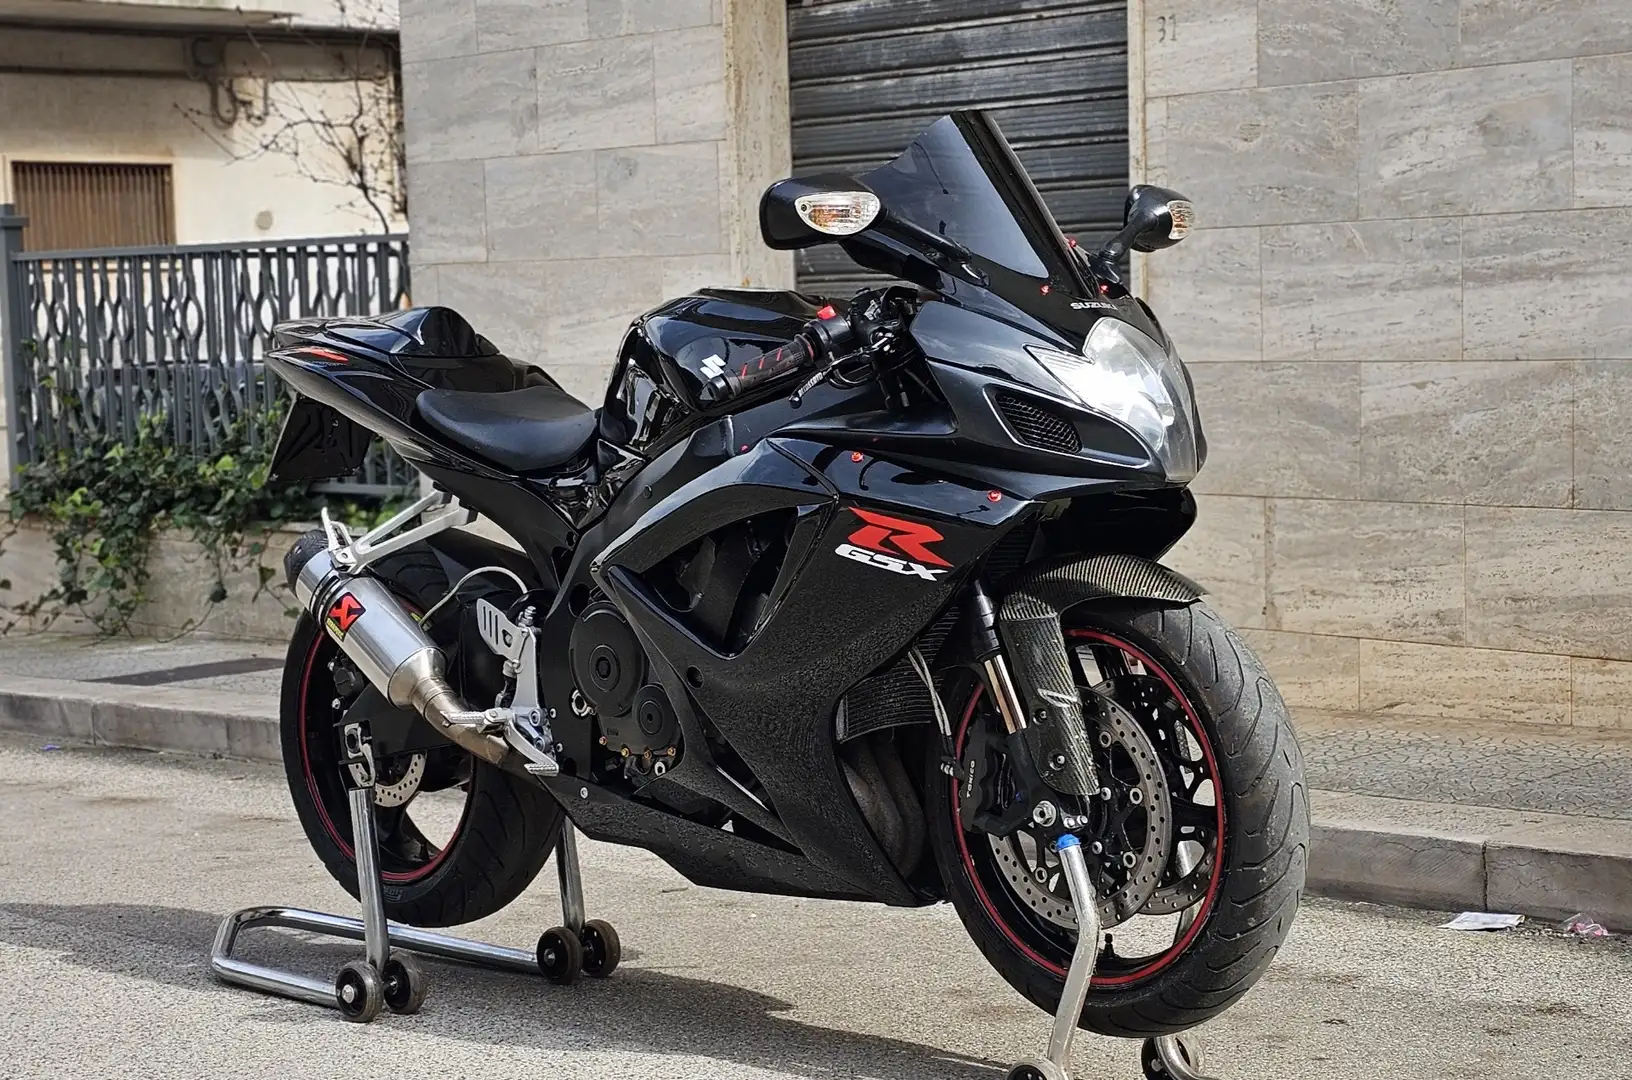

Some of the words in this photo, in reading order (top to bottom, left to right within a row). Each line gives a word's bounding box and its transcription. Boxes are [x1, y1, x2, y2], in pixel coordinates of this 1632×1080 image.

[1156, 13, 1177, 43] 31
[848, 506, 955, 568] R
[834, 543, 949, 582] GSX
